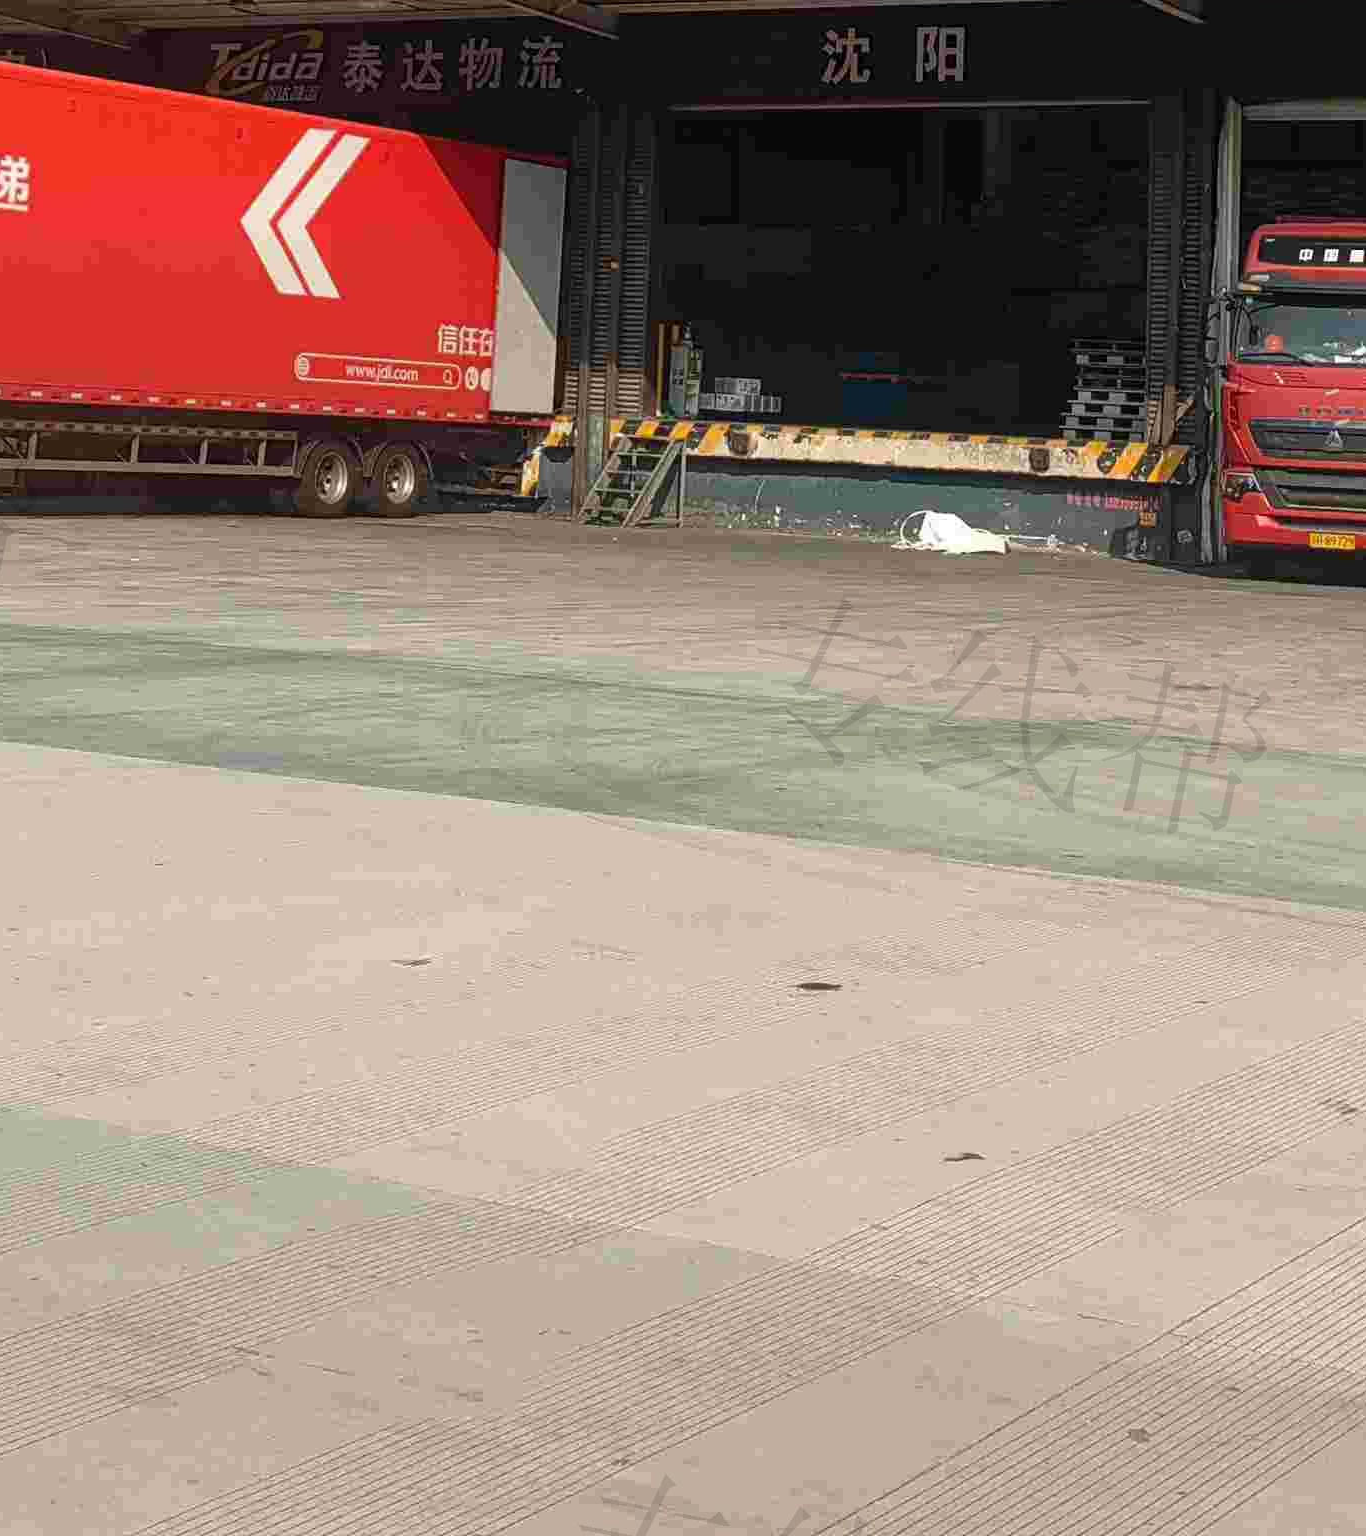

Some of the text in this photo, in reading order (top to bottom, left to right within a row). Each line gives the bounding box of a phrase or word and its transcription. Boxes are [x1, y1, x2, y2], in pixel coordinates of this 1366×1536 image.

[342, 33, 565, 95] 泰达物流
[820, 26, 966, 84] 沈阳
[345, 363, 420, 383] www.jdl.com
